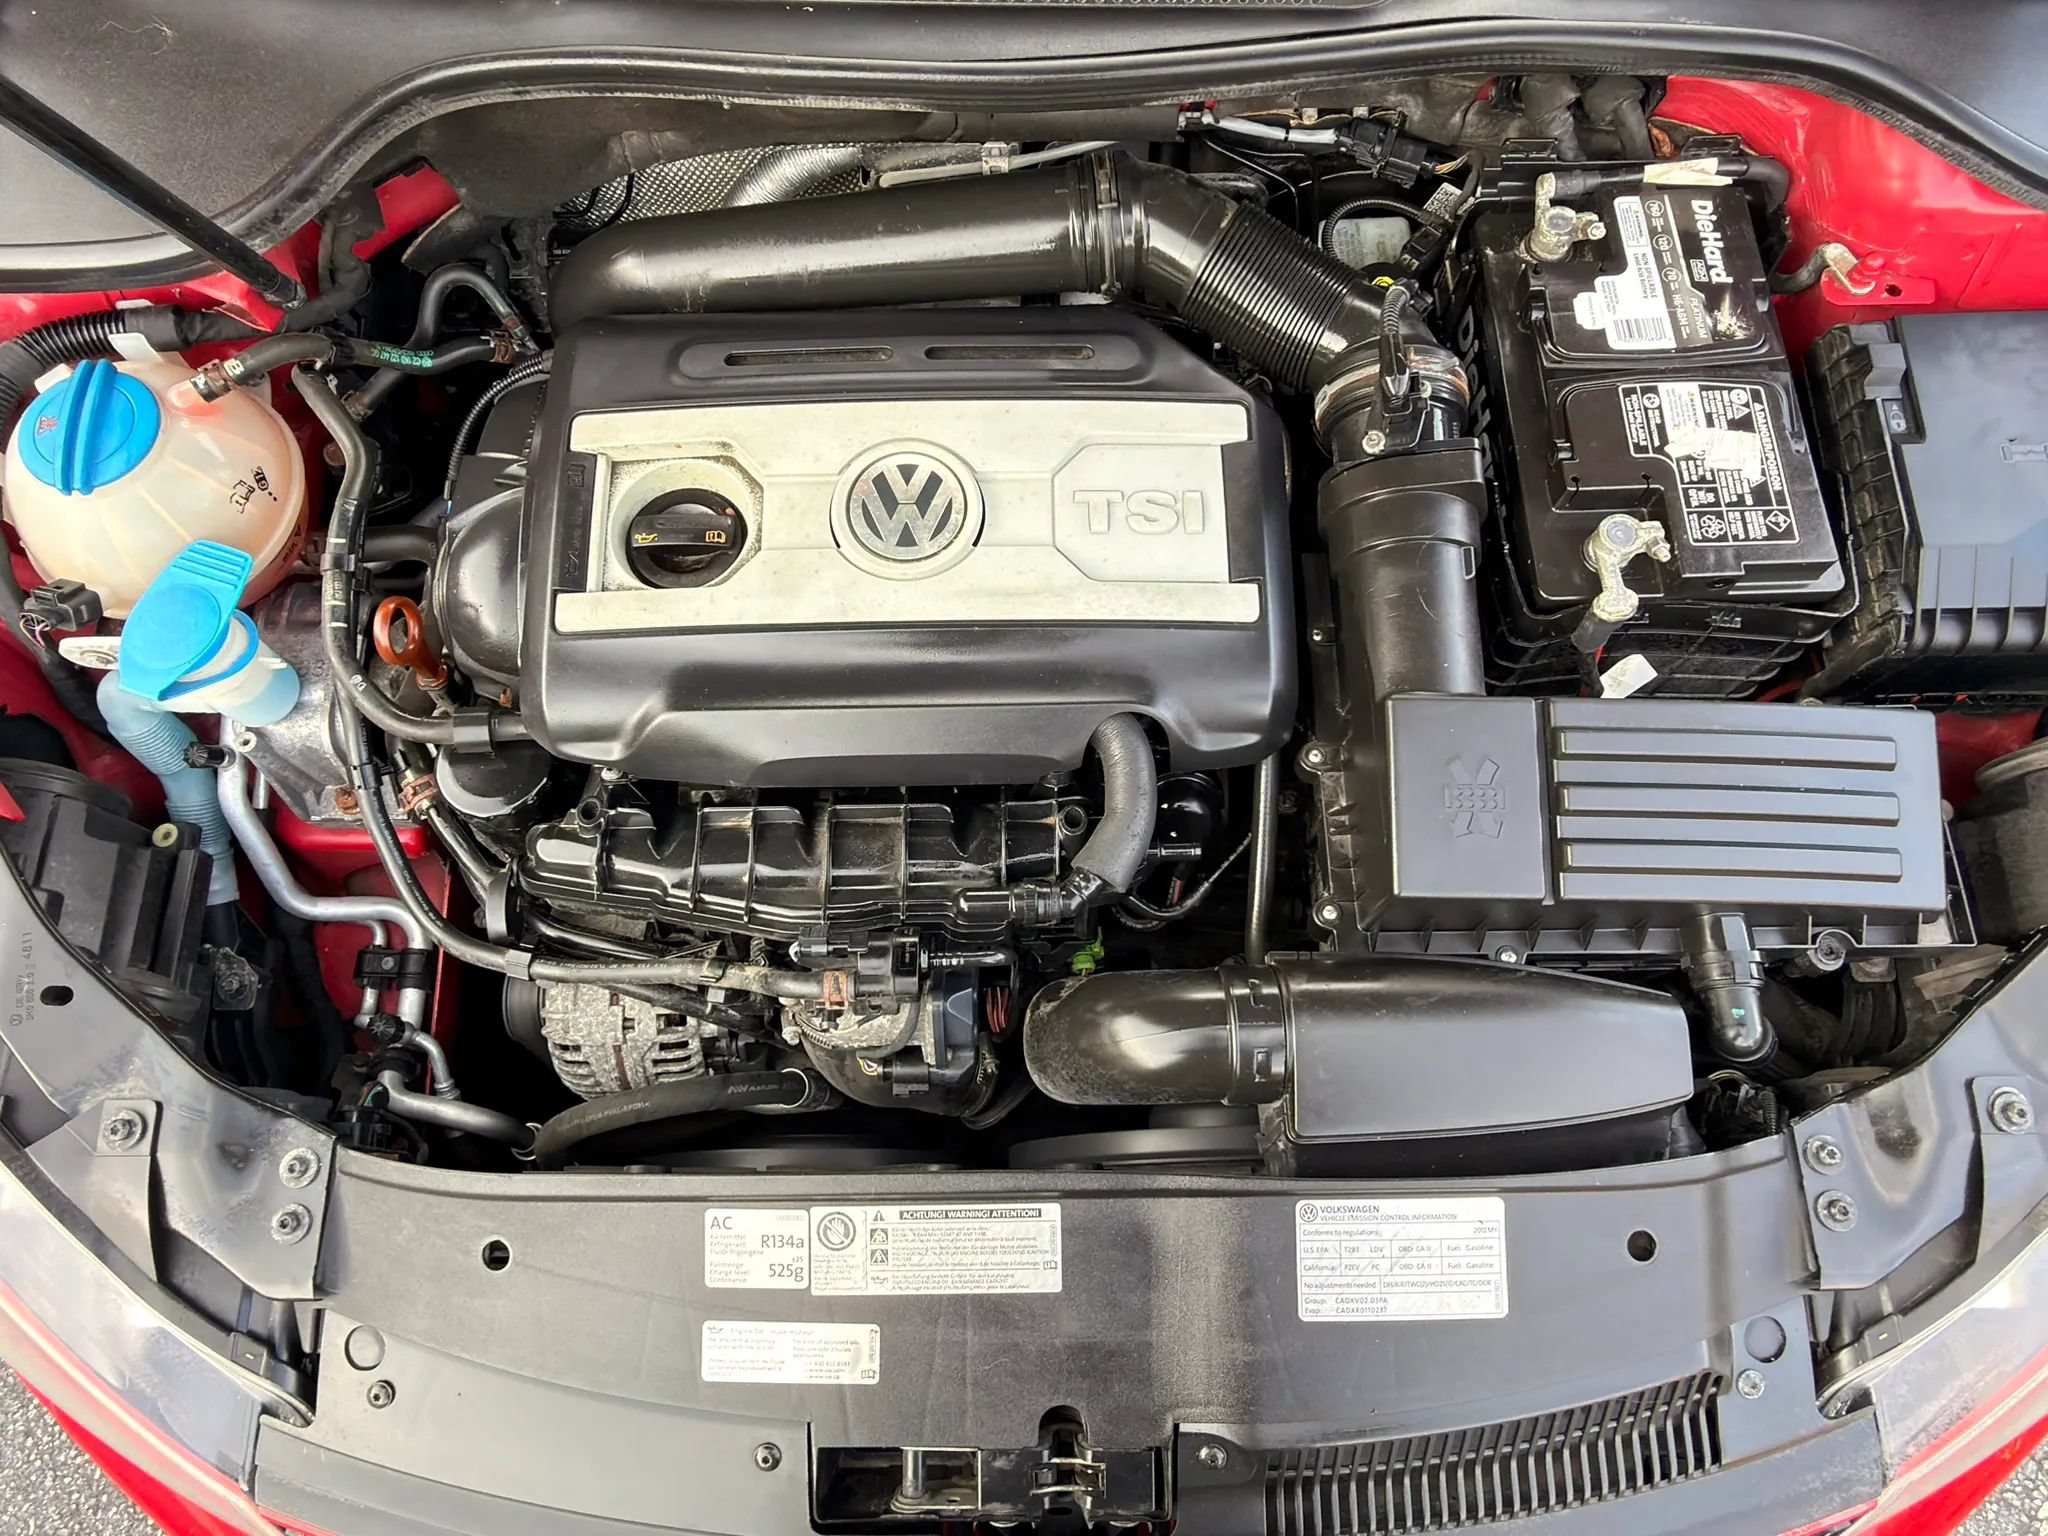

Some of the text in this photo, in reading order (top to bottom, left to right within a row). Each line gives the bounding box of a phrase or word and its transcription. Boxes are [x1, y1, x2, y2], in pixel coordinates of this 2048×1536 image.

[1649, 202, 1661, 217] 760
[1658, 237, 1668, 251] 120
[1691, 200, 1734, 284] DieHard
[1641, 253, 1658, 298] NON SPILLABLE
[1666, 270, 1677, 281] 70
[1640, 279, 1649, 299] Battery
[1672, 294, 1689, 326] H6-AGM
[1689, 297, 1708, 338] PLATINUM
[1631, 394, 1647, 446] NON-SPILLABLE
[1754, 410, 1783, 491] DANGER/POISON
[848, 452, 967, 562] VW
[1073, 489, 1205, 535] TSI
[902, 1209, 1039, 1219] ACHTUNG! WARNING! ATTENTION!
[1320, 1205, 1380, 1214] VOLKSWAGEN
[710, 1216, 733, 1230] AC
[761, 1234, 804, 1248] R134a
[769, 1263, 804, 1282] 525g
[1314, 1282, 1353, 1290] adjustments
